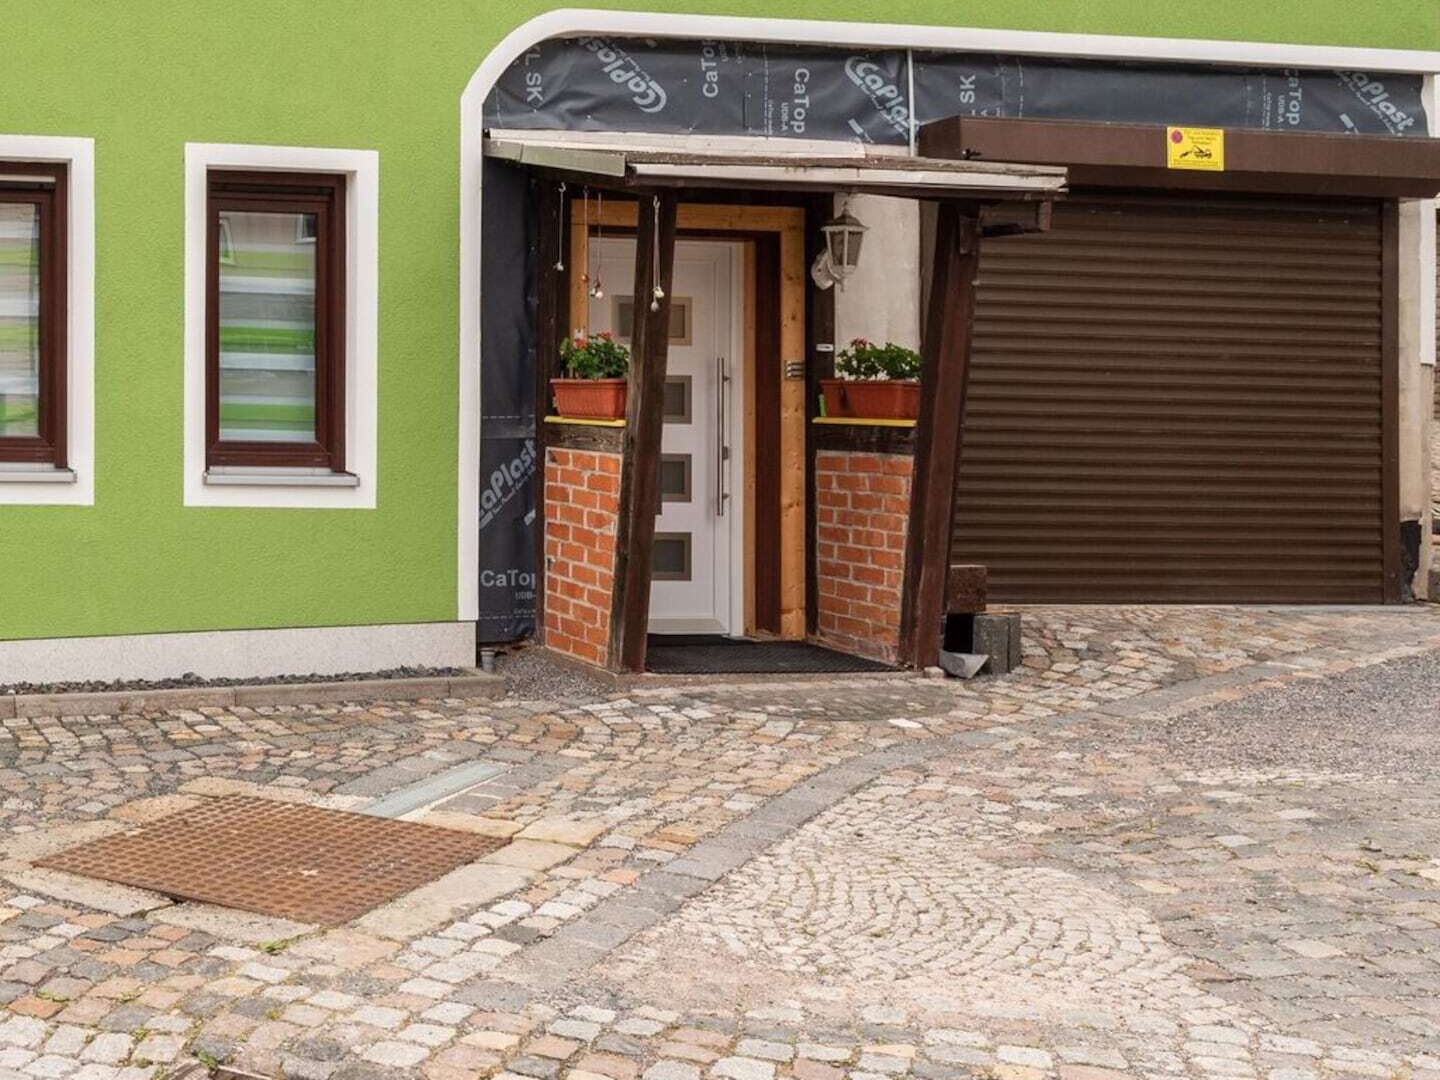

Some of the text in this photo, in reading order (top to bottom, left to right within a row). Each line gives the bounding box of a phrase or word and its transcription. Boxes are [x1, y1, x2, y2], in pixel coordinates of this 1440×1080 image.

[526, 71, 543, 102] SK
[790, 68, 810, 134] CaTop
[960, 74, 976, 104] SK
[1345, 69, 1415, 132] aPlast
[480, 439, 537, 518] aPlast
